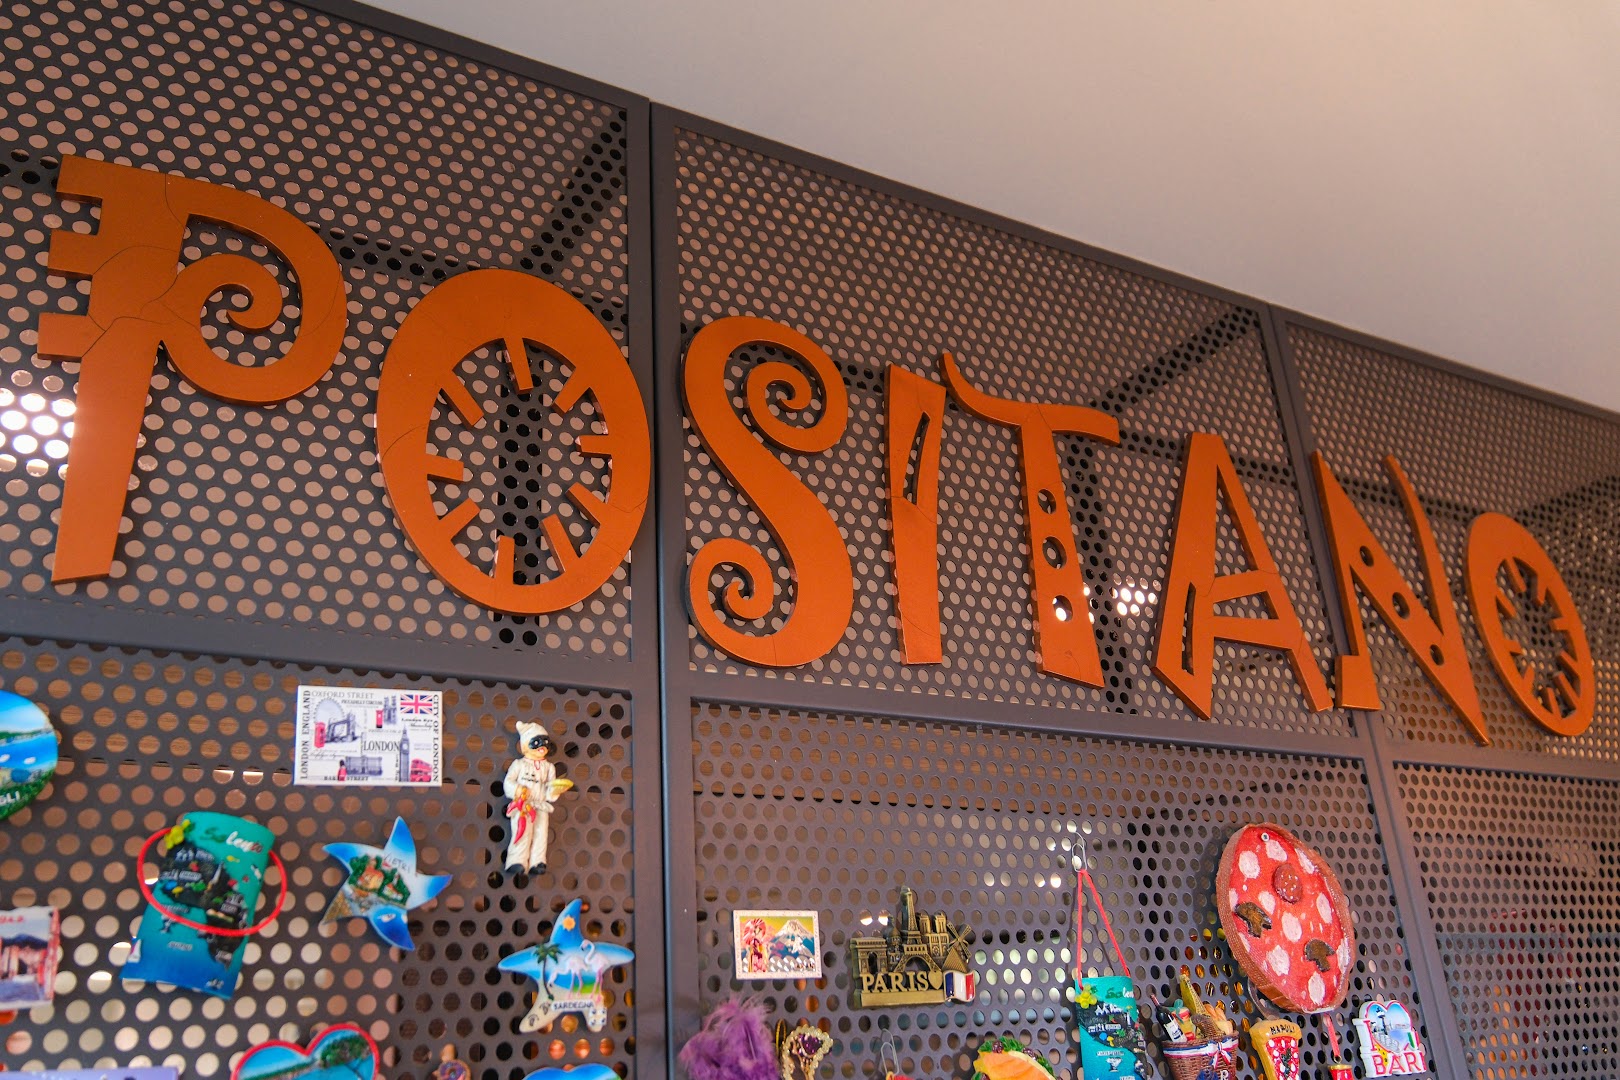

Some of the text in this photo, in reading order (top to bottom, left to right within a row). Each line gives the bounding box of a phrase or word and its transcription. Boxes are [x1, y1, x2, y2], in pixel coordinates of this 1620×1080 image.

[37, 155, 1597, 745] POSITANO
[311, 690, 374, 699] OXFORD STREET
[300, 690, 311, 779] LONDON ENGLAND
[363, 740, 401, 752] LONDON
[432, 694, 440, 782] CITY OF LONDON
[861, 970, 930, 993] PARIS
[553, 1001, 595, 1010] SARDEGNA
[1372, 1052, 1427, 1076] BARI
